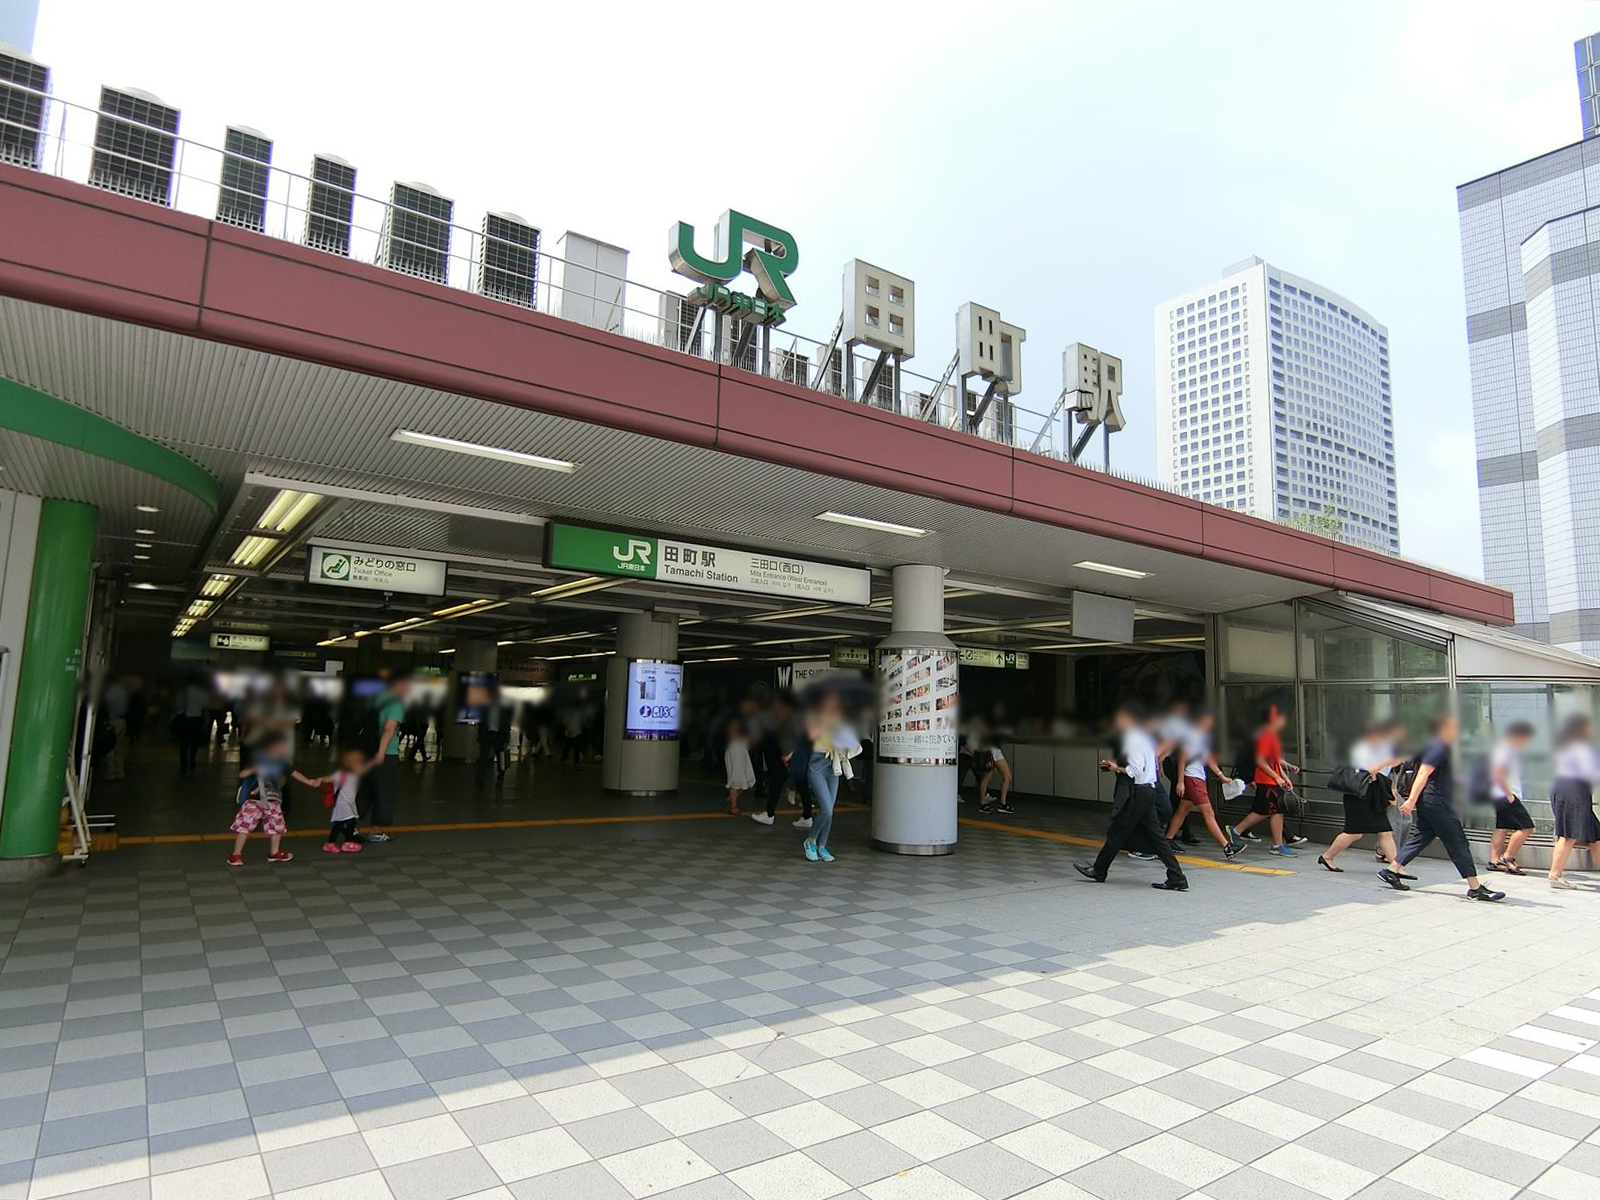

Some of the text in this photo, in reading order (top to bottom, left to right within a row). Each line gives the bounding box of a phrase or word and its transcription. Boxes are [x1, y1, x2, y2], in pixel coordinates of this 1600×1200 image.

[669, 208, 799, 309] JR
[688, 283, 787, 328] JR東日本
[844, 258, 1126, 432] 田町駅
[612, 539, 652, 564] JR
[664, 545, 716, 567] 田町駅
[353, 556, 417, 573] みどりの窓口
[353, 567, 393, 577] Ticket Office
[617, 562, 646, 572] JR東日本
[664, 564, 739, 583] Tamachi Station
[751, 557, 804, 575] 三田口(西口)
[750, 570, 762, 578] Mita
[762, 571, 787, 581] Entrance
[1005, 653, 1015, 662] JR
[795, 669, 807, 680] THE
